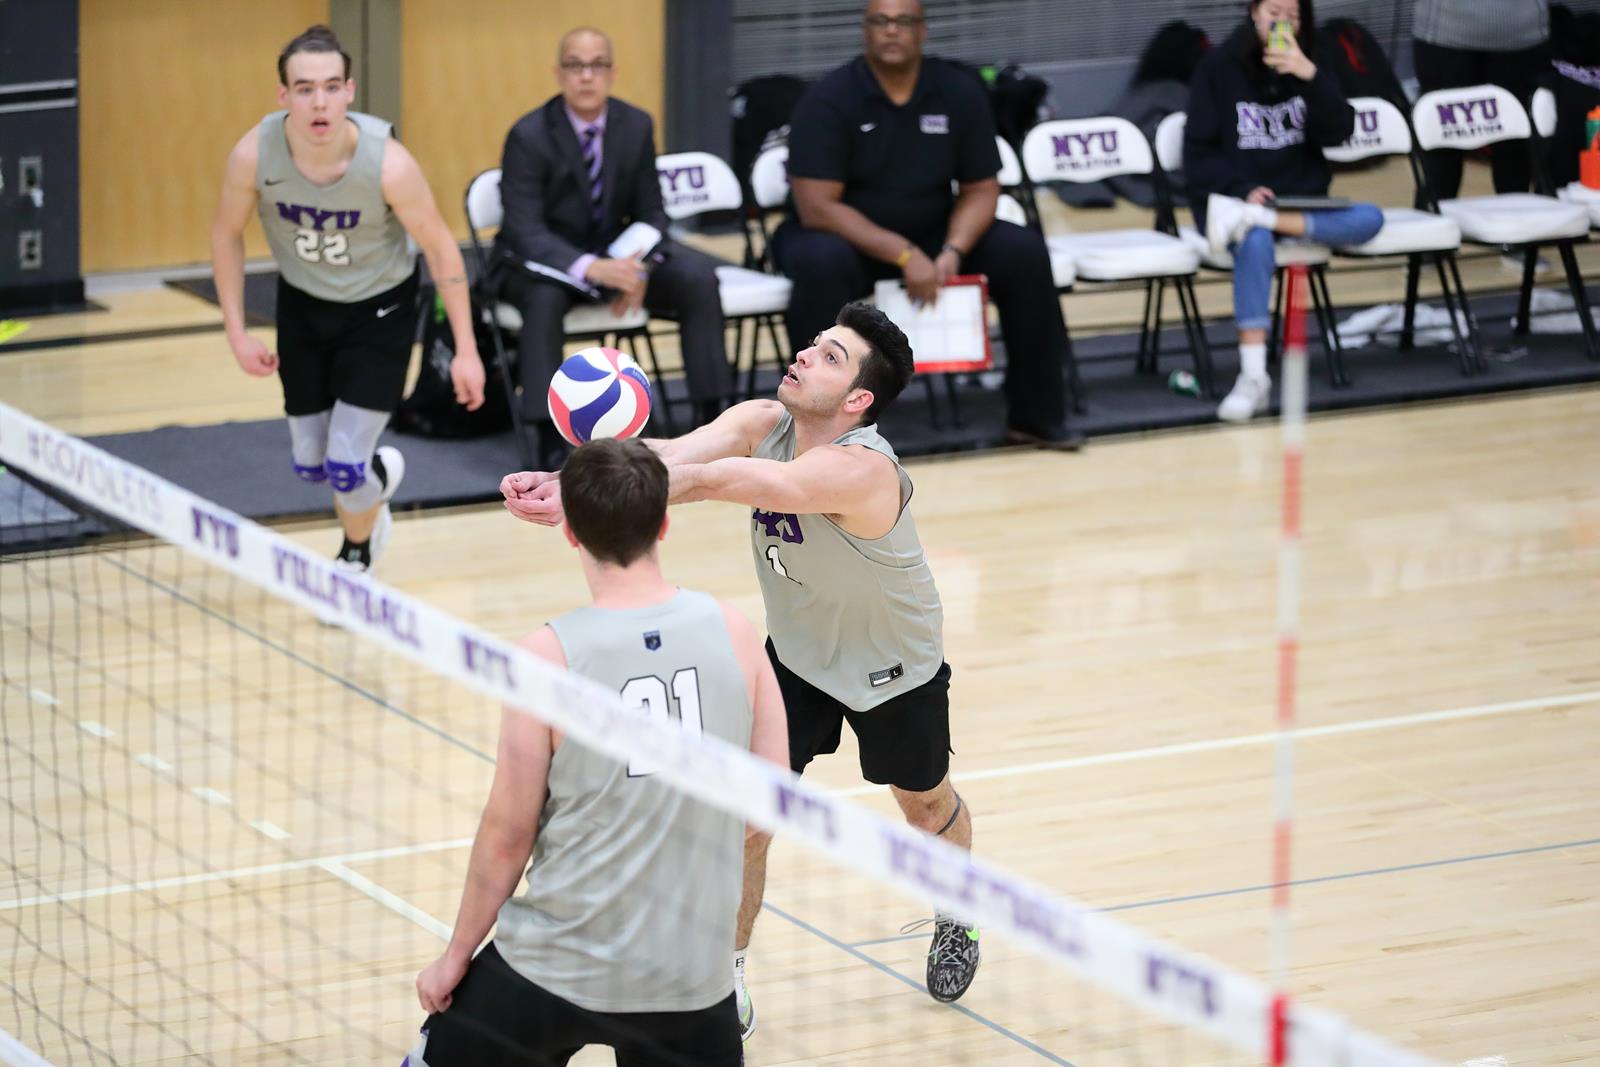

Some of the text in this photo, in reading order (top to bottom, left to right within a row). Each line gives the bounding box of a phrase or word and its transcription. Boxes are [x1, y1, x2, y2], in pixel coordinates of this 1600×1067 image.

[1436, 98, 1498, 125] NYU
[1051, 130, 1117, 157] NYU
[276, 201, 361, 231] NYU
[294, 229, 352, 266] 22
